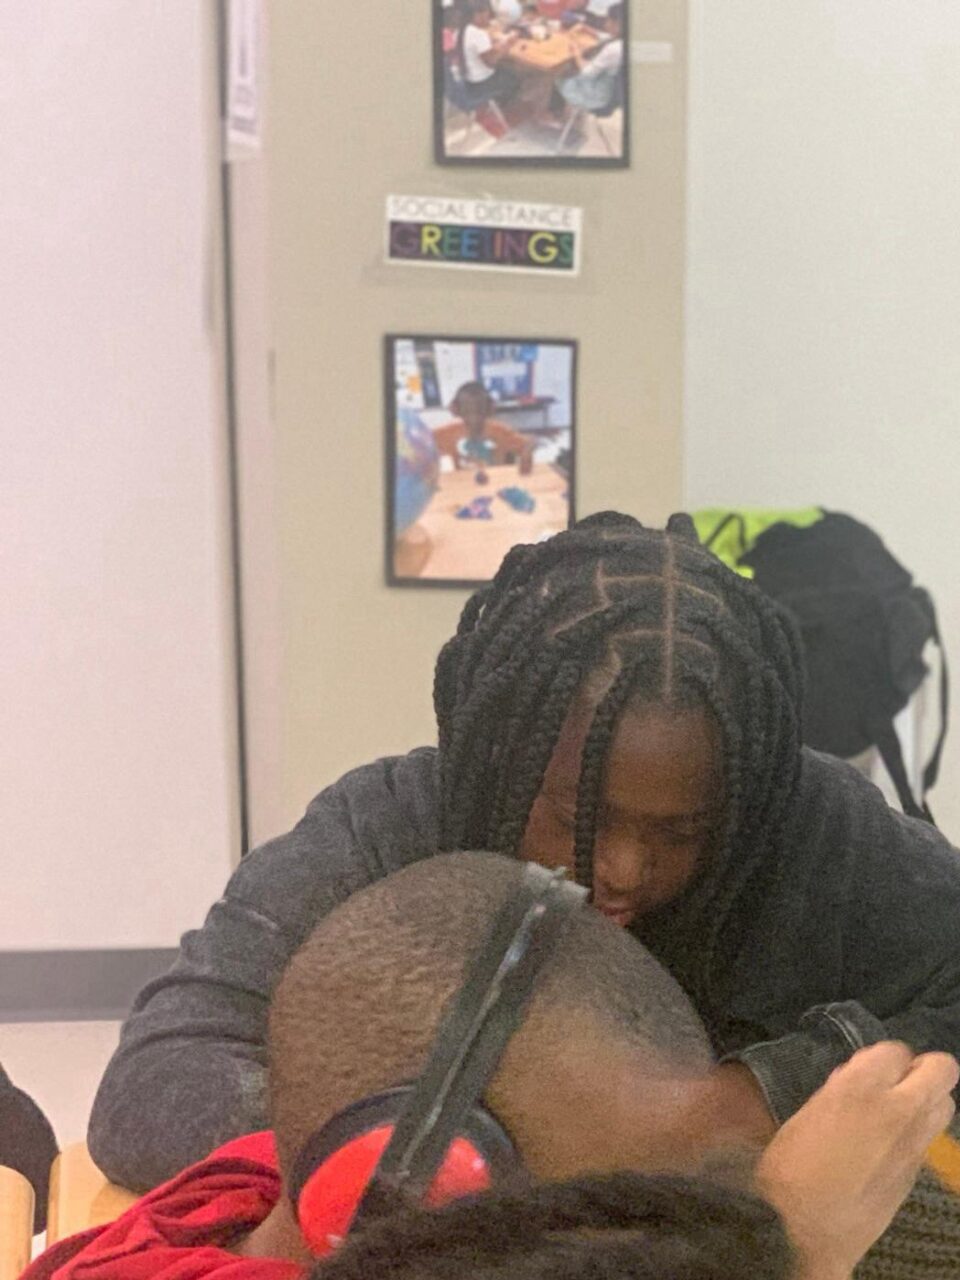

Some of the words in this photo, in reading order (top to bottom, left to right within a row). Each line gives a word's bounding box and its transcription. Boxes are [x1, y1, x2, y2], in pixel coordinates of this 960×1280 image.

[392, 200, 467, 220] SOCIAL
[475, 203, 575, 228] DISTANCE
[392, 223, 574, 264] GREETINGS
